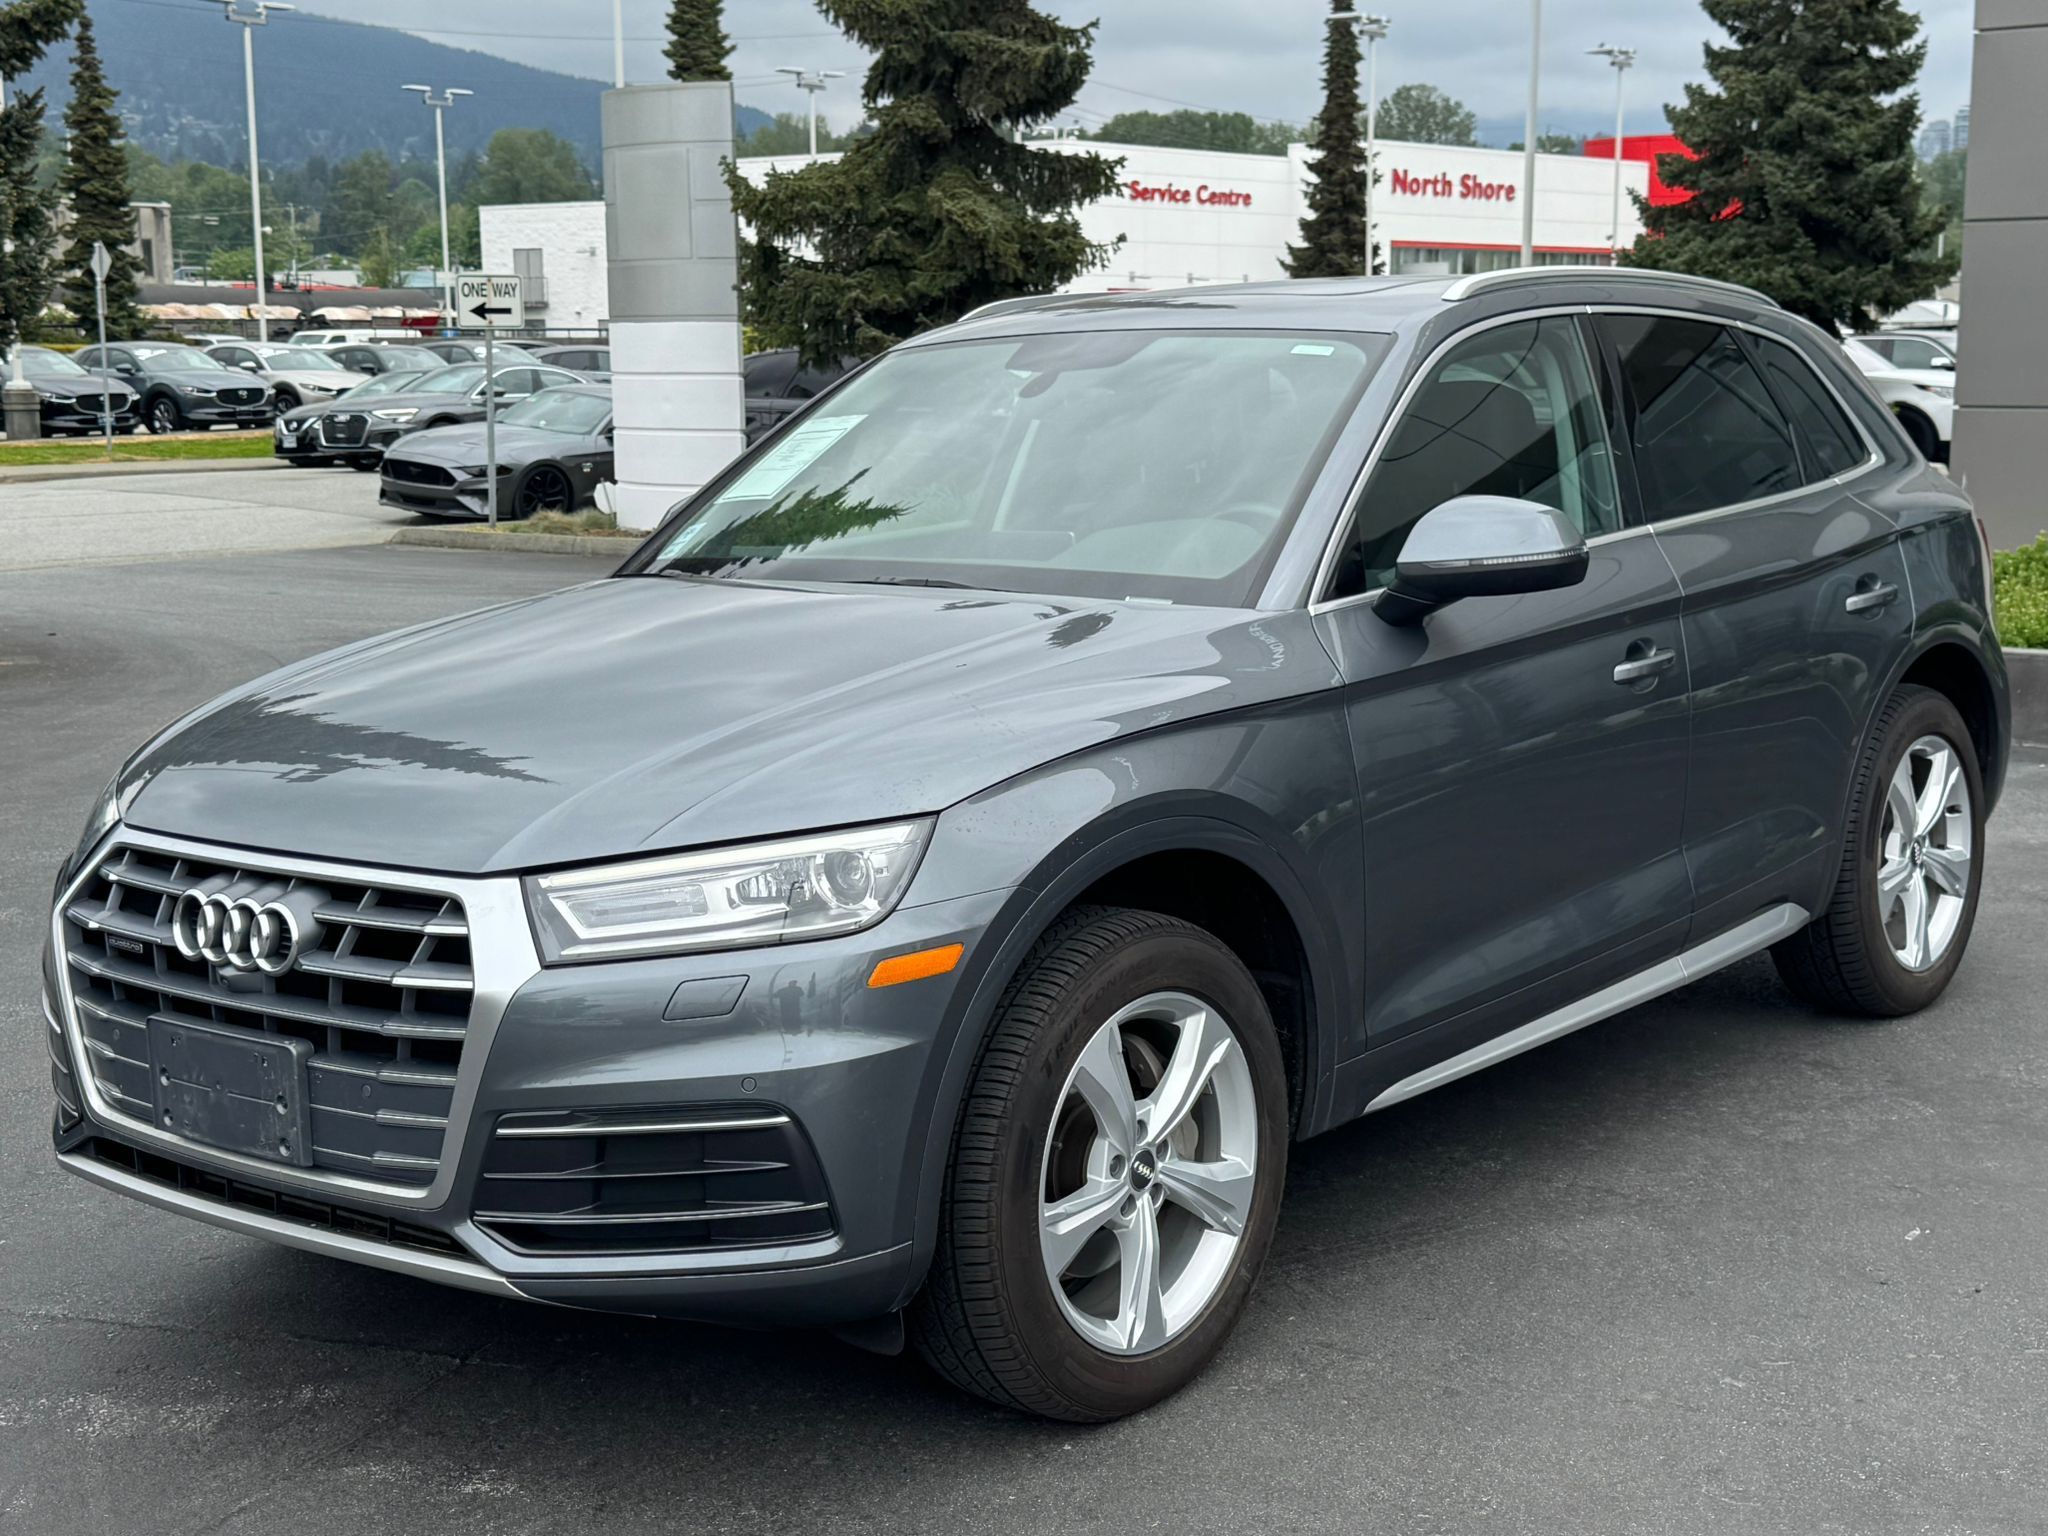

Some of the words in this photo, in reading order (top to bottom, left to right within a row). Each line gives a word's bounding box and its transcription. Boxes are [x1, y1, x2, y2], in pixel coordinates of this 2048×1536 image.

[1129, 180, 1191, 203] Service
[1196, 184, 1252, 206] Centre
[1391, 168, 1452, 197] North
[1459, 173, 1516, 201] Shore
[461, 282, 488, 298] ONE
[492, 282, 518, 298] WAY
